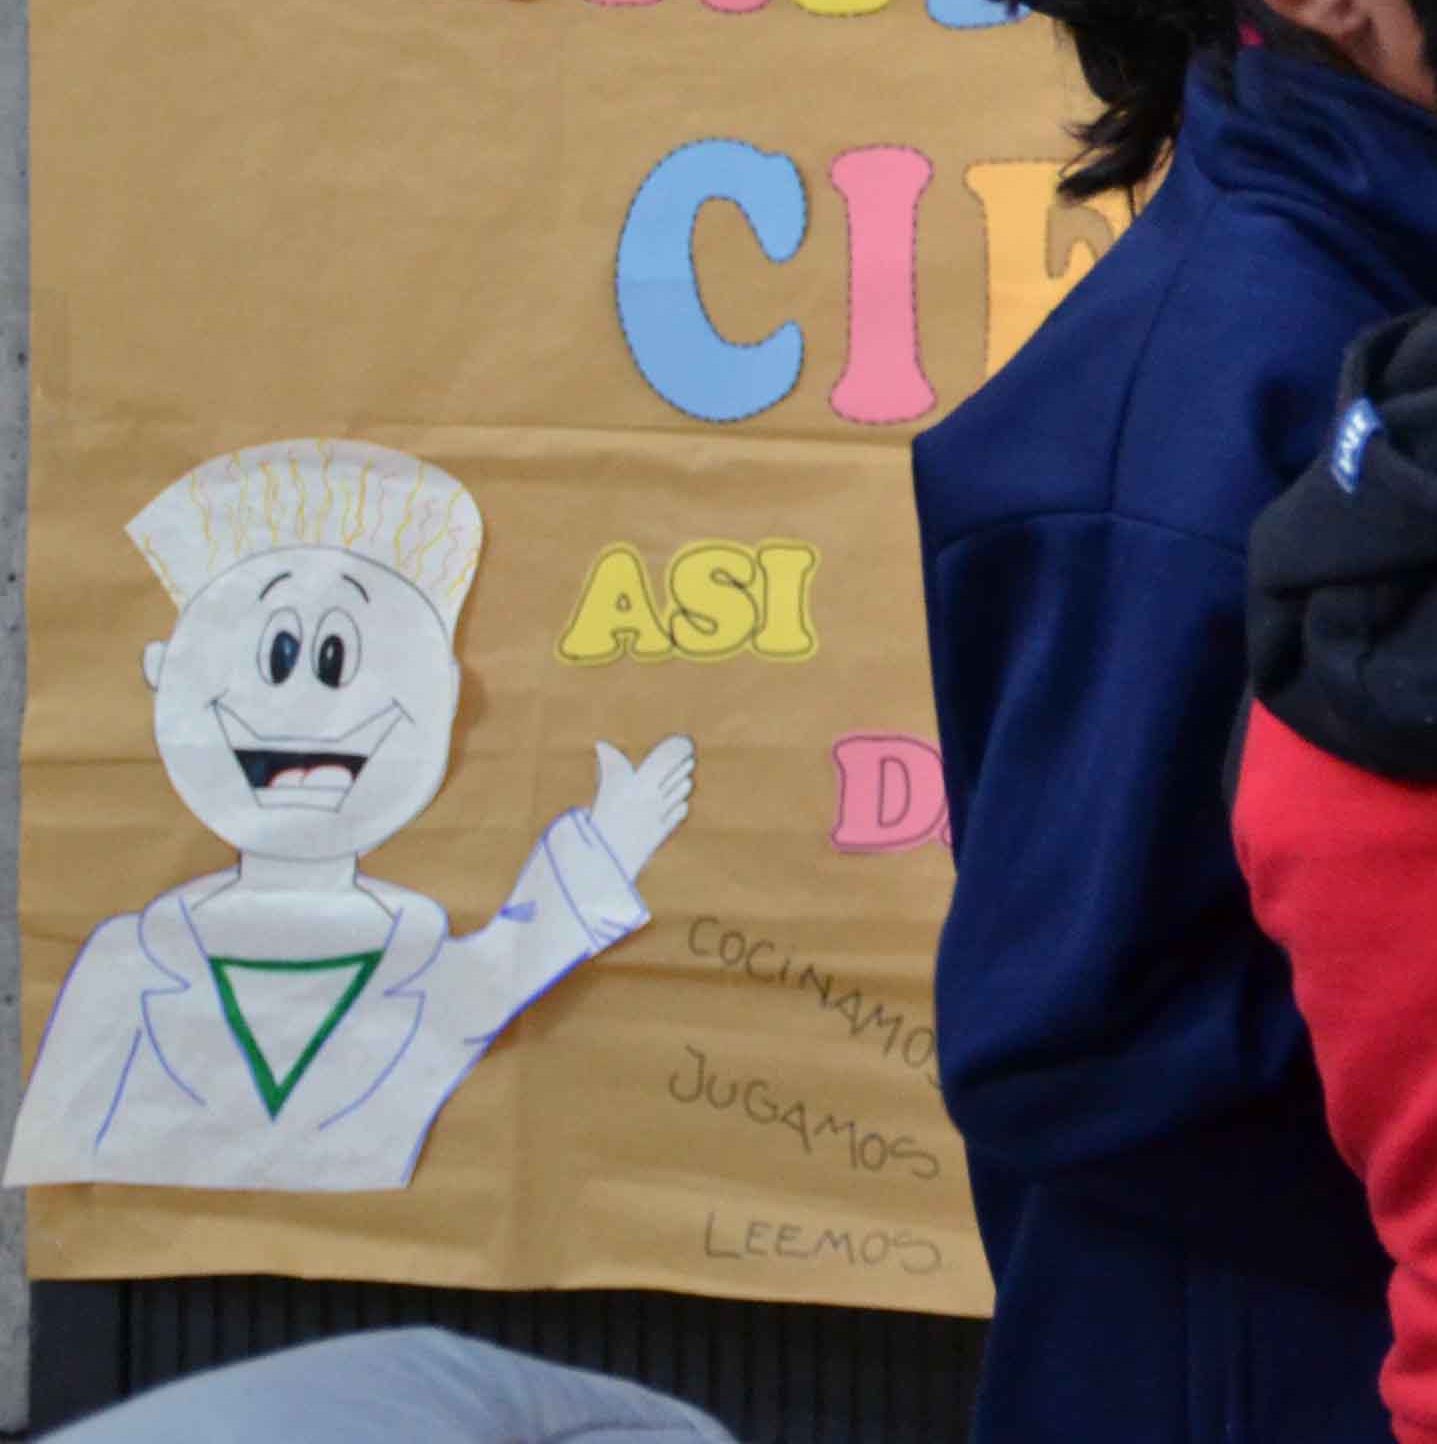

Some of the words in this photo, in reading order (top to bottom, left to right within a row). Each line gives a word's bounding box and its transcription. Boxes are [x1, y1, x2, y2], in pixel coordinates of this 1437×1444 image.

[556, 540, 819, 663] ASI
[668, 1043, 941, 1181] JUGAMOS
[703, 1210, 943, 1275] LEEMOS
